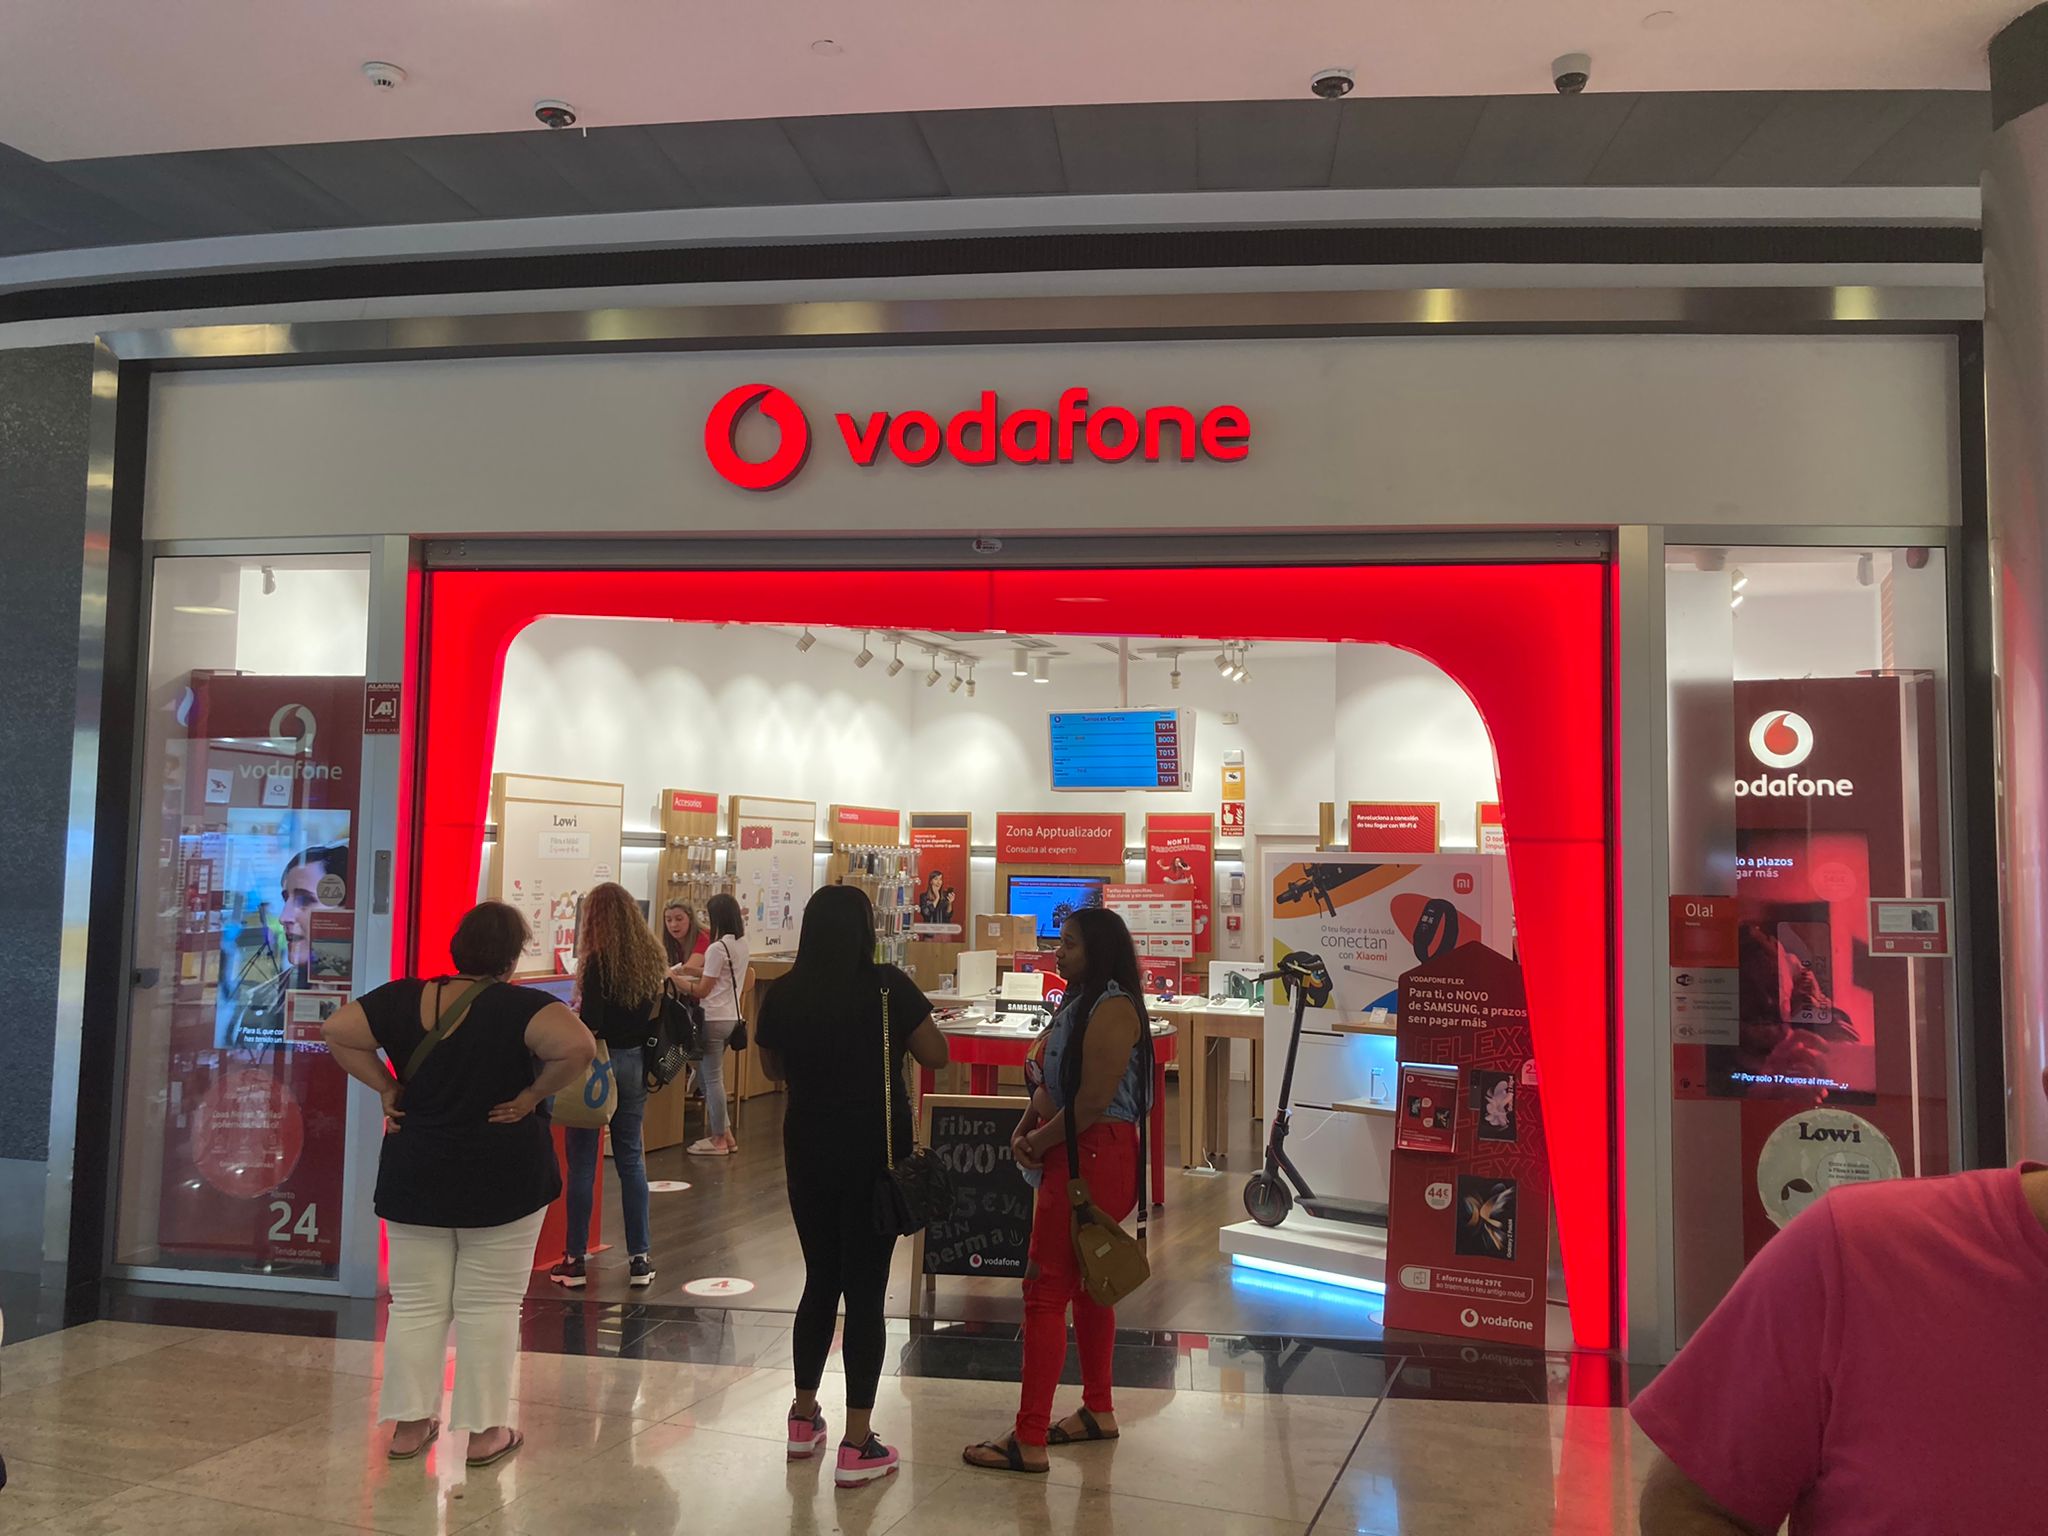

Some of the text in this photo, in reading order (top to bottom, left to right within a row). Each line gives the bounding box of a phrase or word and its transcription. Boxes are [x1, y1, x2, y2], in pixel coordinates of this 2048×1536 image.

[835, 387, 1252, 467] vodafone
[239, 759, 343, 780] vodafone
[1734, 773, 1854, 797] odafone
[553, 814, 577, 827] Lowi
[1006, 825, 1113, 839] Zona Apptualizador
[1005, 845, 1038, 854] Consulta
[1048, 847, 1077, 855] experto
[1735, 856, 1794, 868] lo a plazos
[1736, 868, 1779, 880] gar más
[1685, 903, 1714, 917] Ola!
[556, 925, 575, 945] ÚN
[1339, 926, 1358, 935] fogar
[1381, 927, 1395, 935] vida
[765, 935, 781, 945] Lowi
[1320, 934, 1388, 950] conectan
[1338, 951, 1388, 961] con Xiaomi
[1409, 976, 1464, 985] VODAFONE FLEX
[1409, 987, 1432, 998] Para
[1434, 989, 1445, 1000] ti,
[1456, 990, 1489, 1001] NOVO
[1007, 1003, 1043, 1011] SAMSUNG
[1408, 1001, 1528, 1017] de SAMSUNG, a prazos
[1408, 1015, 1487, 1028] sen pagar máis
[1741, 1073, 1755, 1082] Por
[1755, 1074, 1772, 1083] solo
[1774, 1075, 1784, 1083] 17
[1807, 1077, 1815, 1085] al
[938, 1115, 997, 1136] fibra
[1798, 1122, 1861, 1144] Lowi
[1428, 1186, 1449, 1199] 44€
[268, 1201, 319, 1243] 24
[984, 1257, 1020, 1267] vodafone
[1441, 1274, 1462, 1283] aforra
[1463, 1276, 1484, 1286] desde
[1476, 1286, 1486, 1294] teu
[1487, 1287, 1507, 1297] antigo
[1481, 1315, 1533, 1330] vodafone
